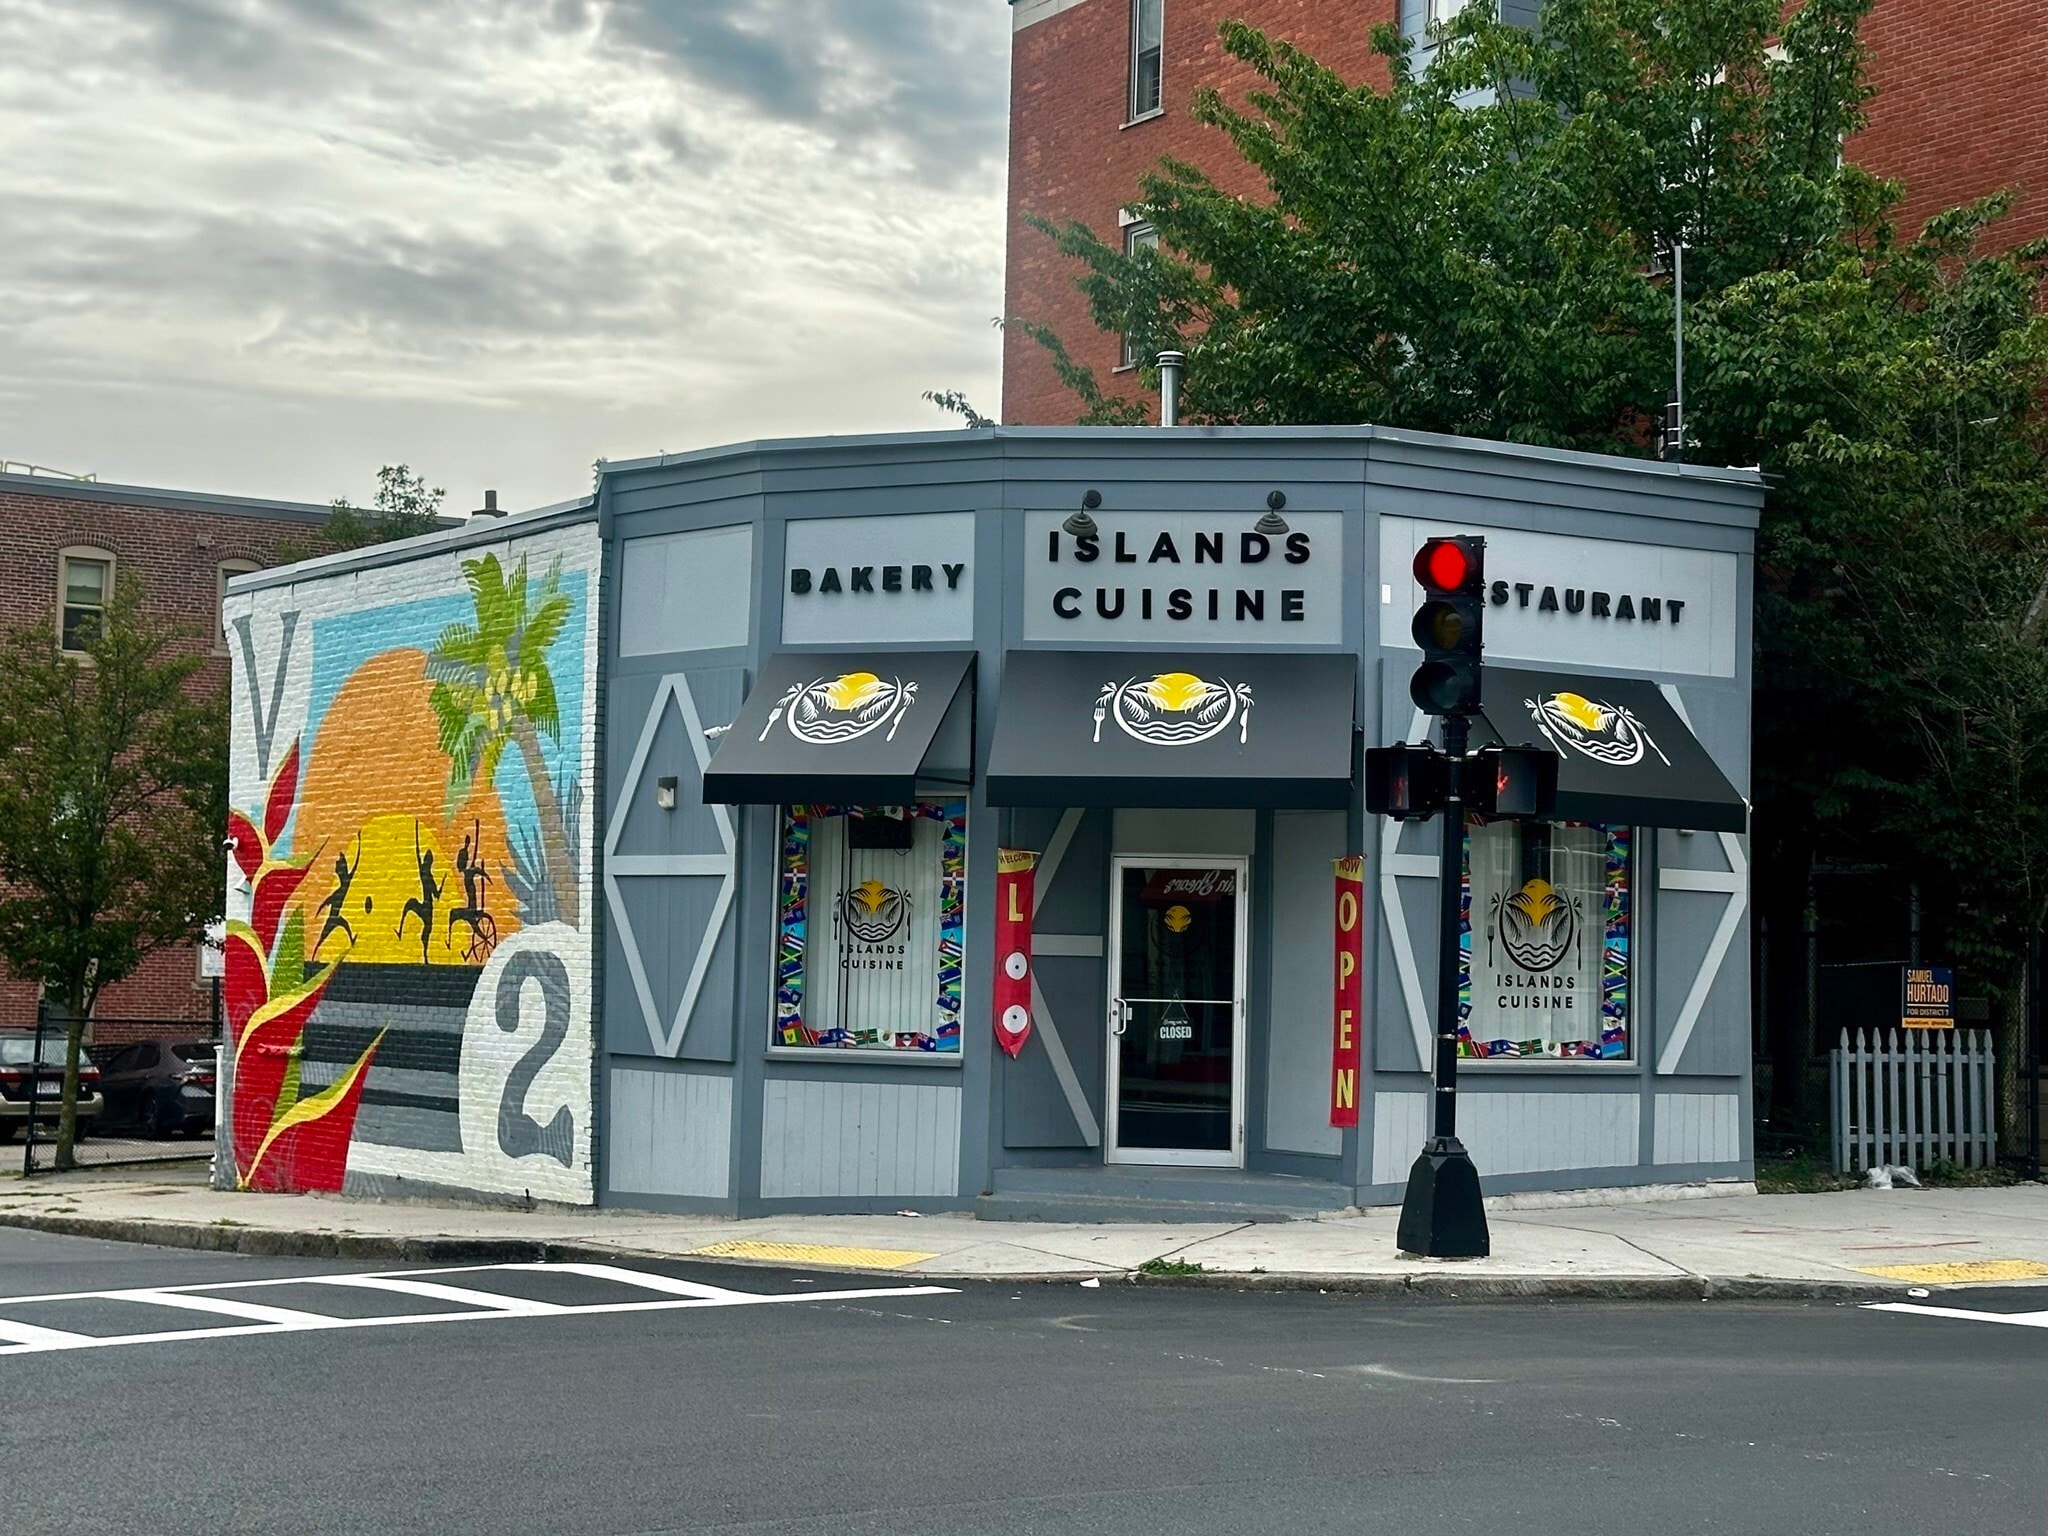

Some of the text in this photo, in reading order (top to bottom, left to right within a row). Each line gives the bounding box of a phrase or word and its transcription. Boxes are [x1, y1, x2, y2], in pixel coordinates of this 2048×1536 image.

[1049, 531, 1310, 564] ISLANDS
[791, 563, 965, 594] BAKERY
[1053, 587, 1304, 621] CUISINE
[1491, 580, 1685, 624] STAURANT
[1338, 859, 1361, 873] NOW
[840, 944, 905, 955] ISLANDS
[842, 960, 904, 970] CUISINE
[1496, 974, 1575, 989] ISLANDS
[1907, 969, 1934, 983] SAMUEL
[1336, 891, 1358, 1108] OPEN
[1907, 983, 1949, 1003] HURTADO
[1498, 995, 1573, 1009] CUISINE
[1907, 1008, 1919, 1016] FOR
[1920, 1008, 1944, 1016] DISTRICT
[1160, 1026, 1192, 1039] CLOSED
[495, 949, 574, 1169] 2
